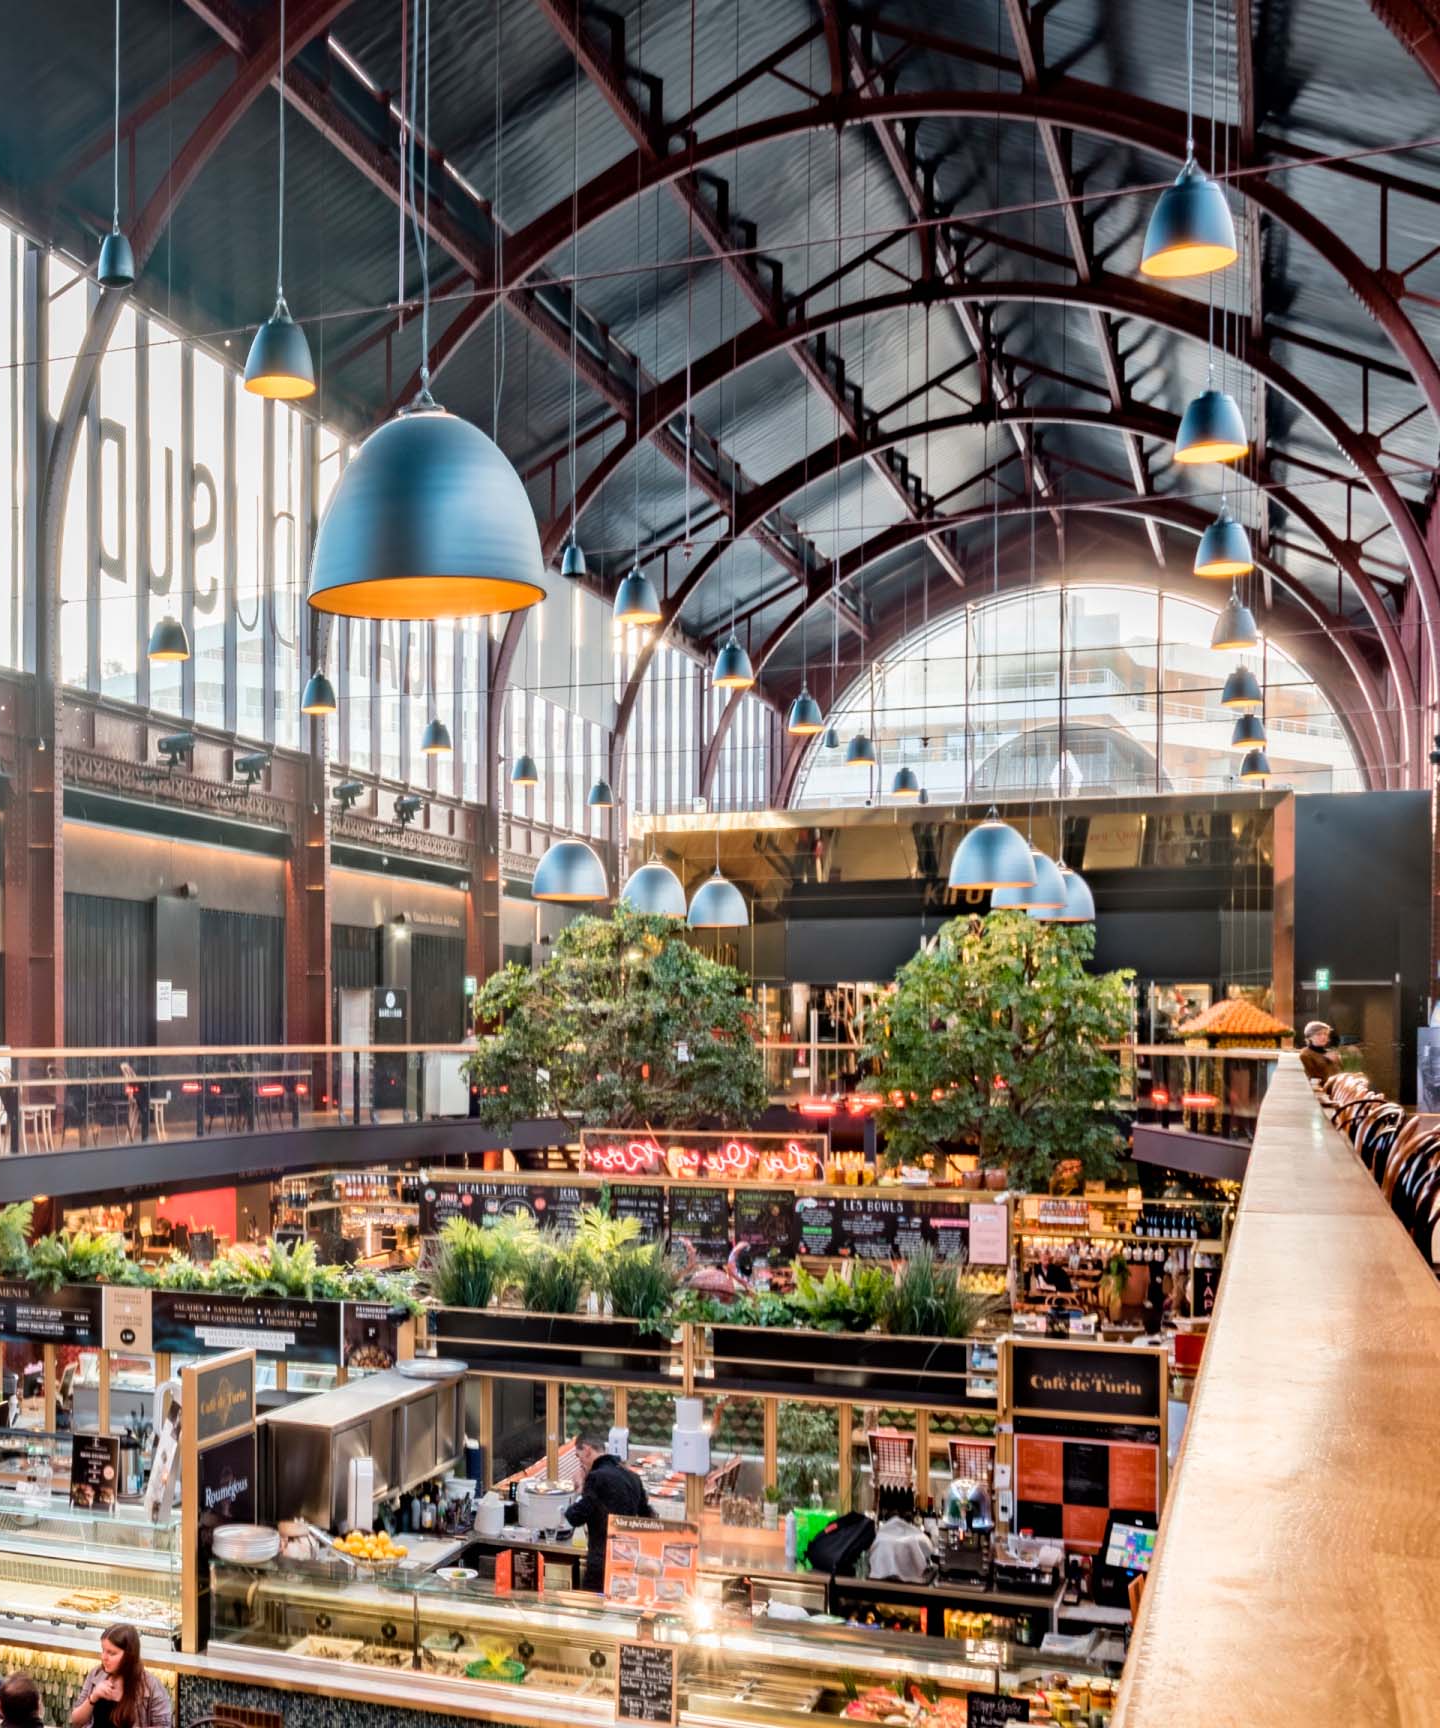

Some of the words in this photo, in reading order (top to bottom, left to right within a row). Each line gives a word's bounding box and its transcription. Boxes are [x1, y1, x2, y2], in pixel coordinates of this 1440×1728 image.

[502, 1185, 528, 1197] JUICE
[843, 1199, 863, 1212] LES
[867, 1200, 904, 1213] BOWLS
[1203, 1272, 1215, 1316] TAP
[174, 1303, 204, 1312] SALADES
[1030, 1374, 1067, 1390] Café
[1070, 1377, 1090, 1392] de
[1091, 1378, 1142, 1396] Turin
[205, 1478, 248, 1508] Roumégous
[614, 1517, 628, 1527] Nos
